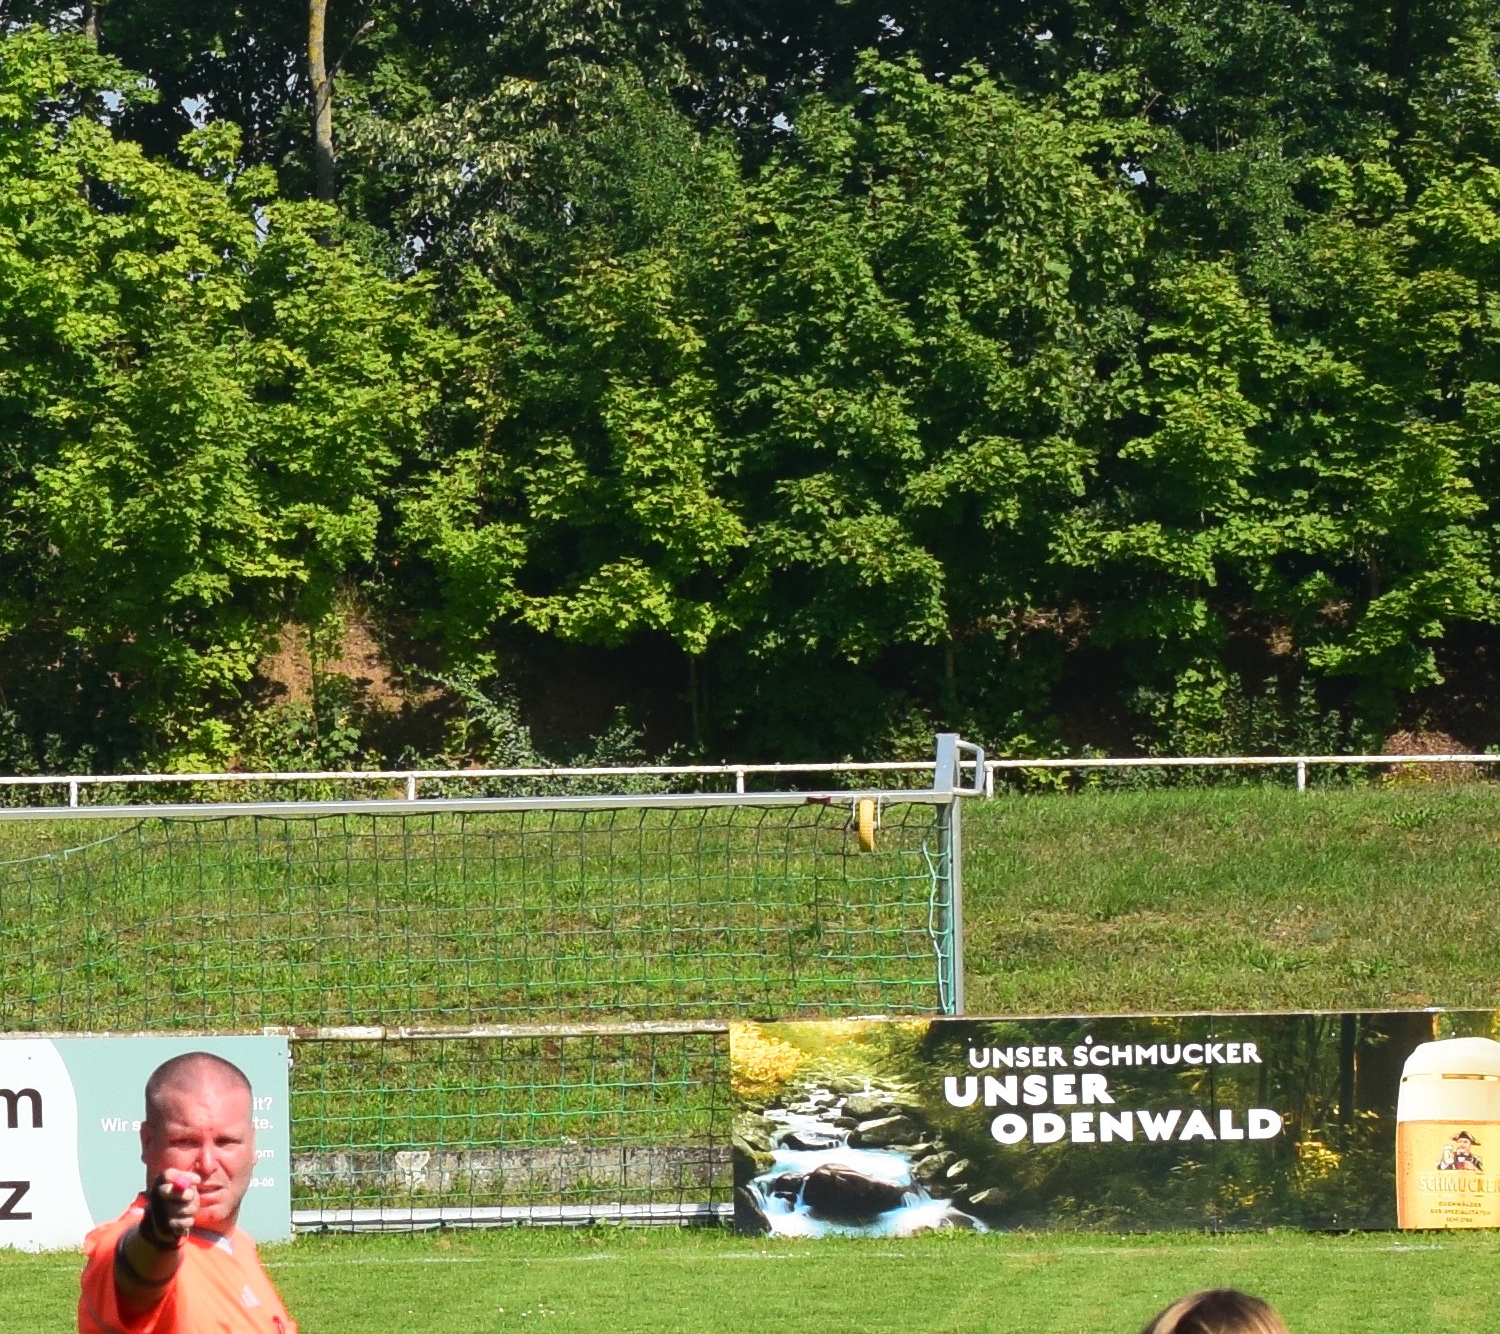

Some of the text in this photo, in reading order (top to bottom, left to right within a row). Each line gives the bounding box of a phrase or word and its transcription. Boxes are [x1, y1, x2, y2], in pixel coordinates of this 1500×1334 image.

[968, 1042, 1263, 1068] UNSER SCHMUCKER
[944, 1073, 1116, 1108] UNSER
[101, 1118, 128, 1132] Wir
[991, 1108, 1283, 1145] ODENWALD
